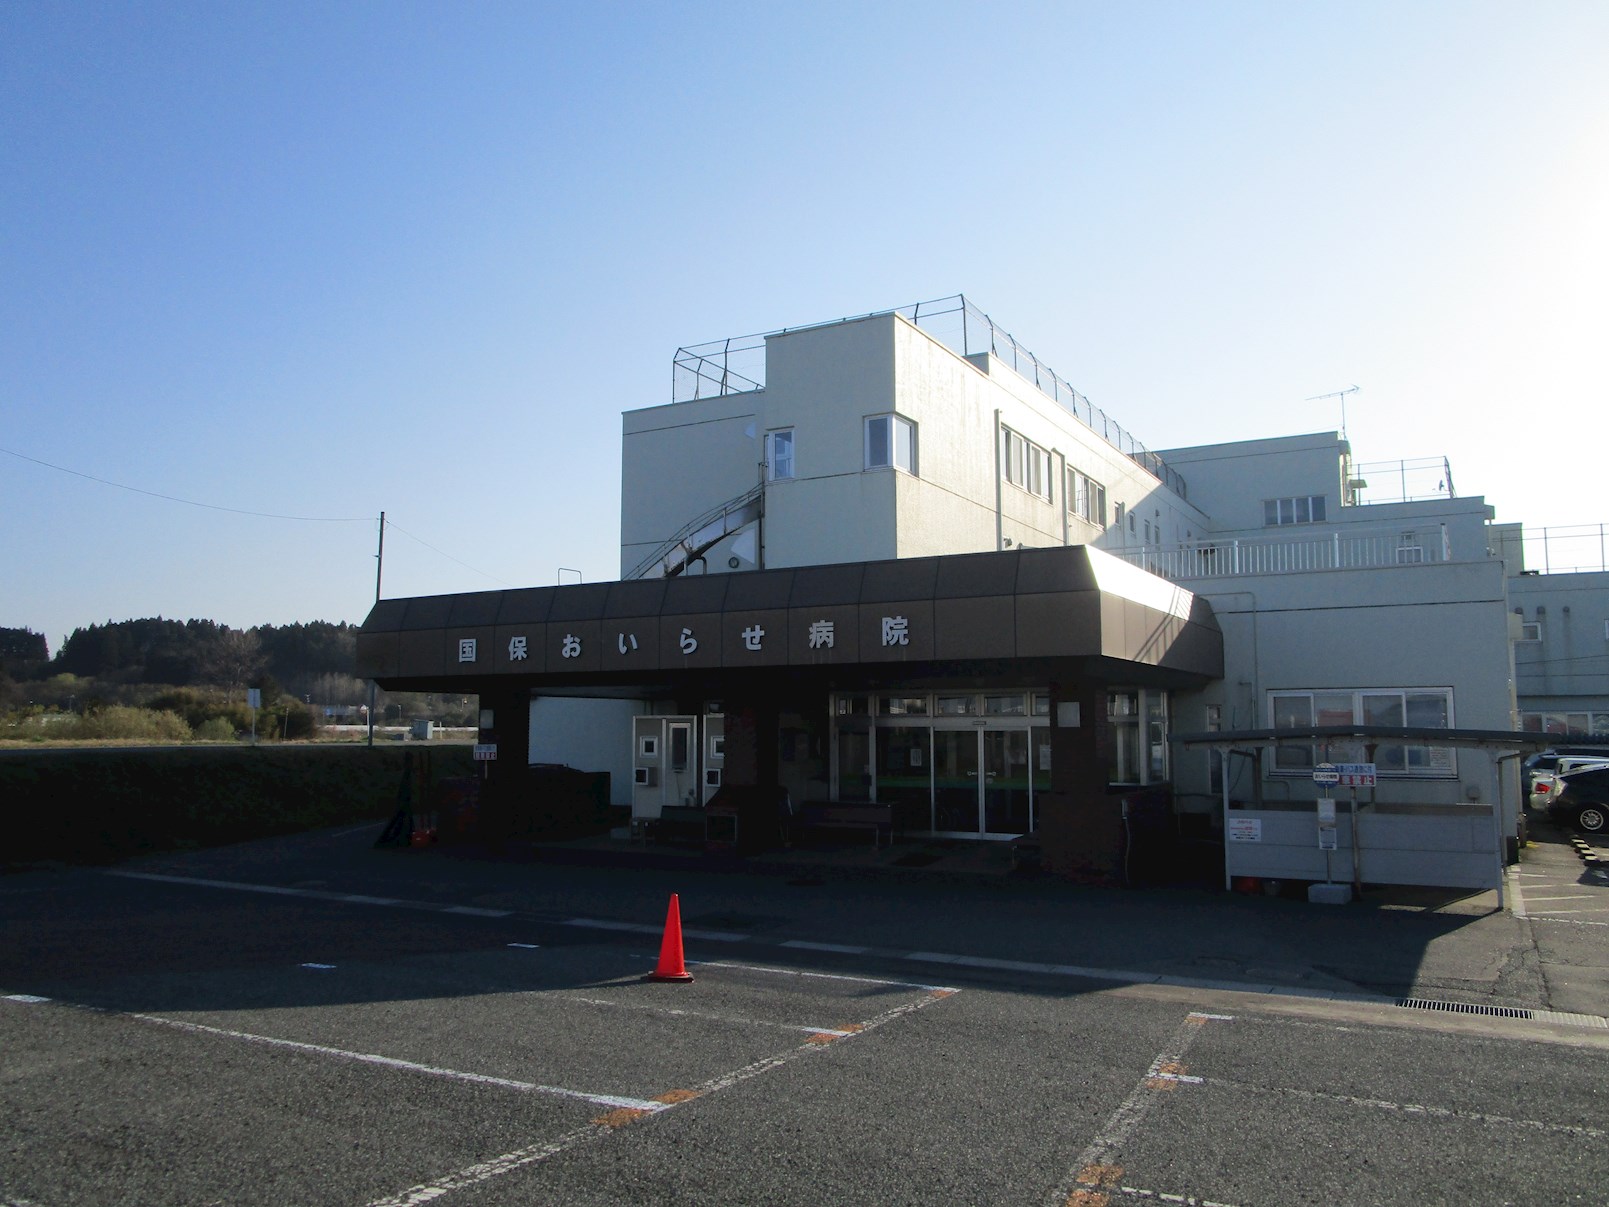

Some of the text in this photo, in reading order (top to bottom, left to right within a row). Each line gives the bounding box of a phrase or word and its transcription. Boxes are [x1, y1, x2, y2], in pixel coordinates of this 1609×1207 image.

[458, 615, 909, 664] 国保おいらせ病院
